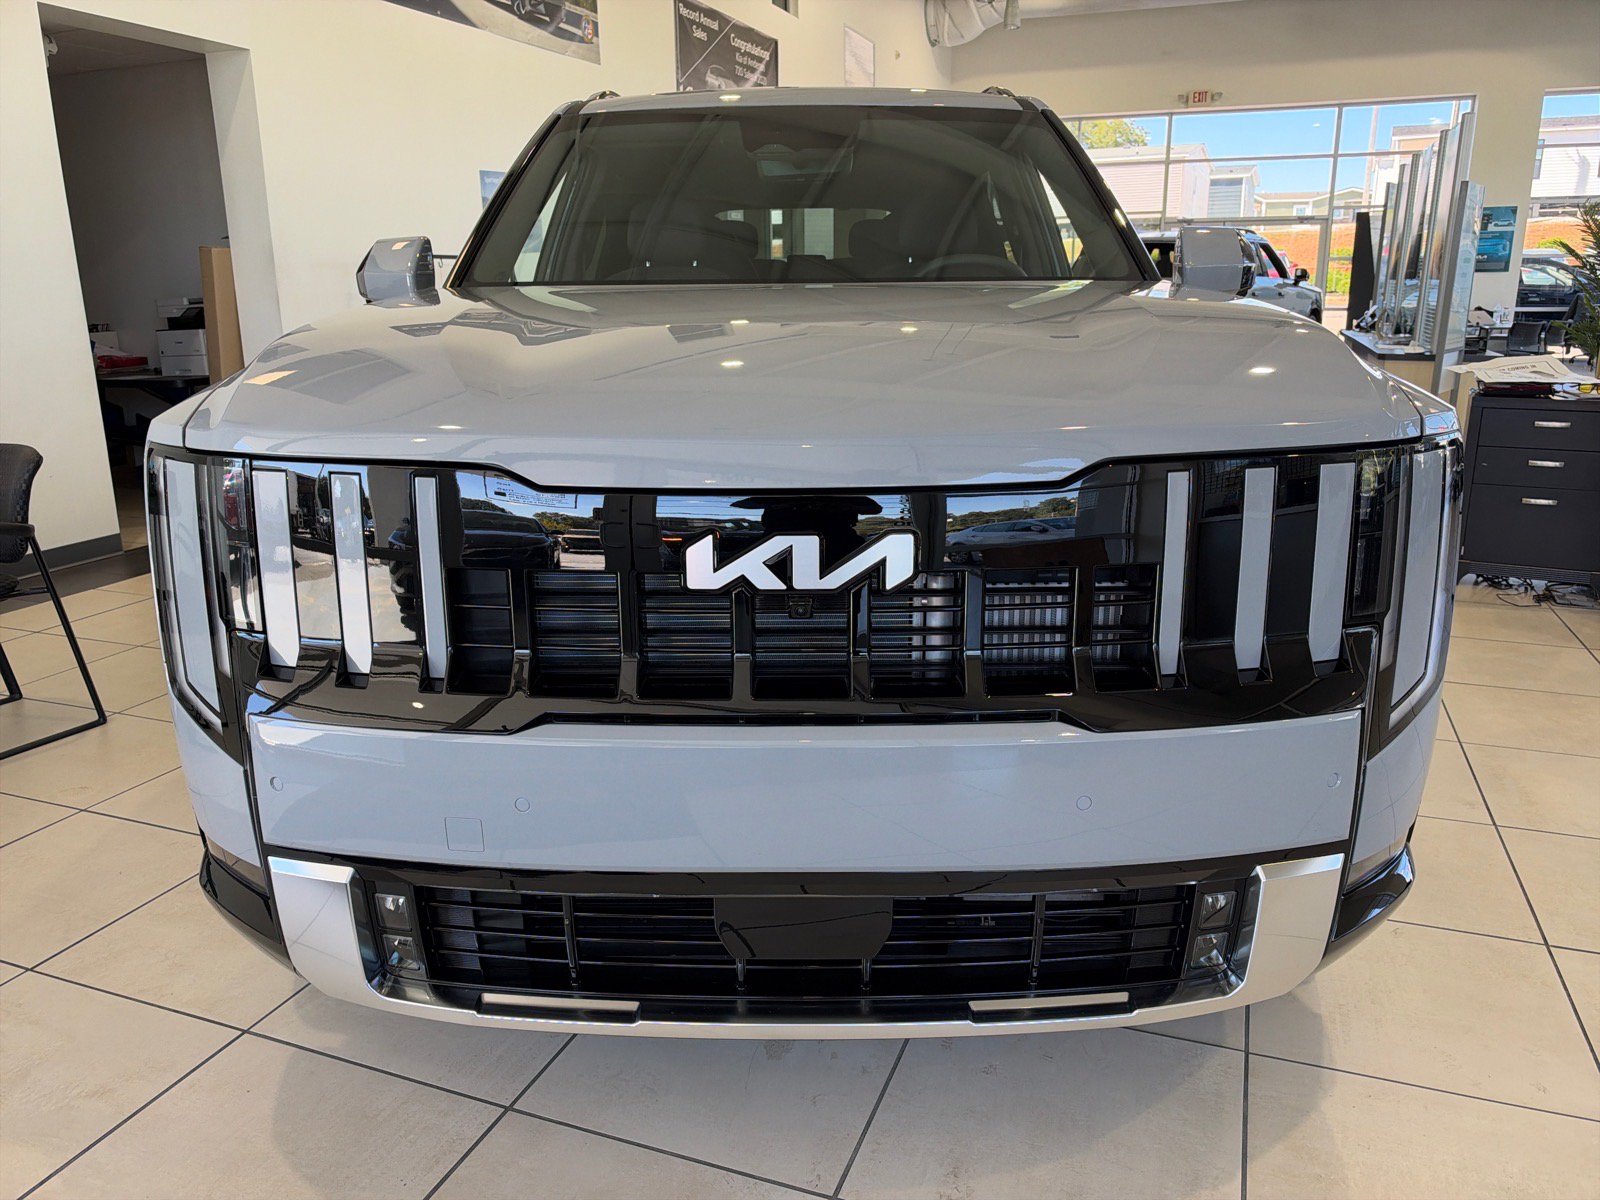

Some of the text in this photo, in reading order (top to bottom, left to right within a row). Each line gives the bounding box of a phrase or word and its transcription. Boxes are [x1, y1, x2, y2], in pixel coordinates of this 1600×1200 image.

[679, 3, 719, 31] Record Annual
[692, 25, 708, 41] Sales
[730, 33, 770, 60] Congratulations
[1192, 91, 1208, 103] EXIT
[686, 534, 914, 590] KIA
